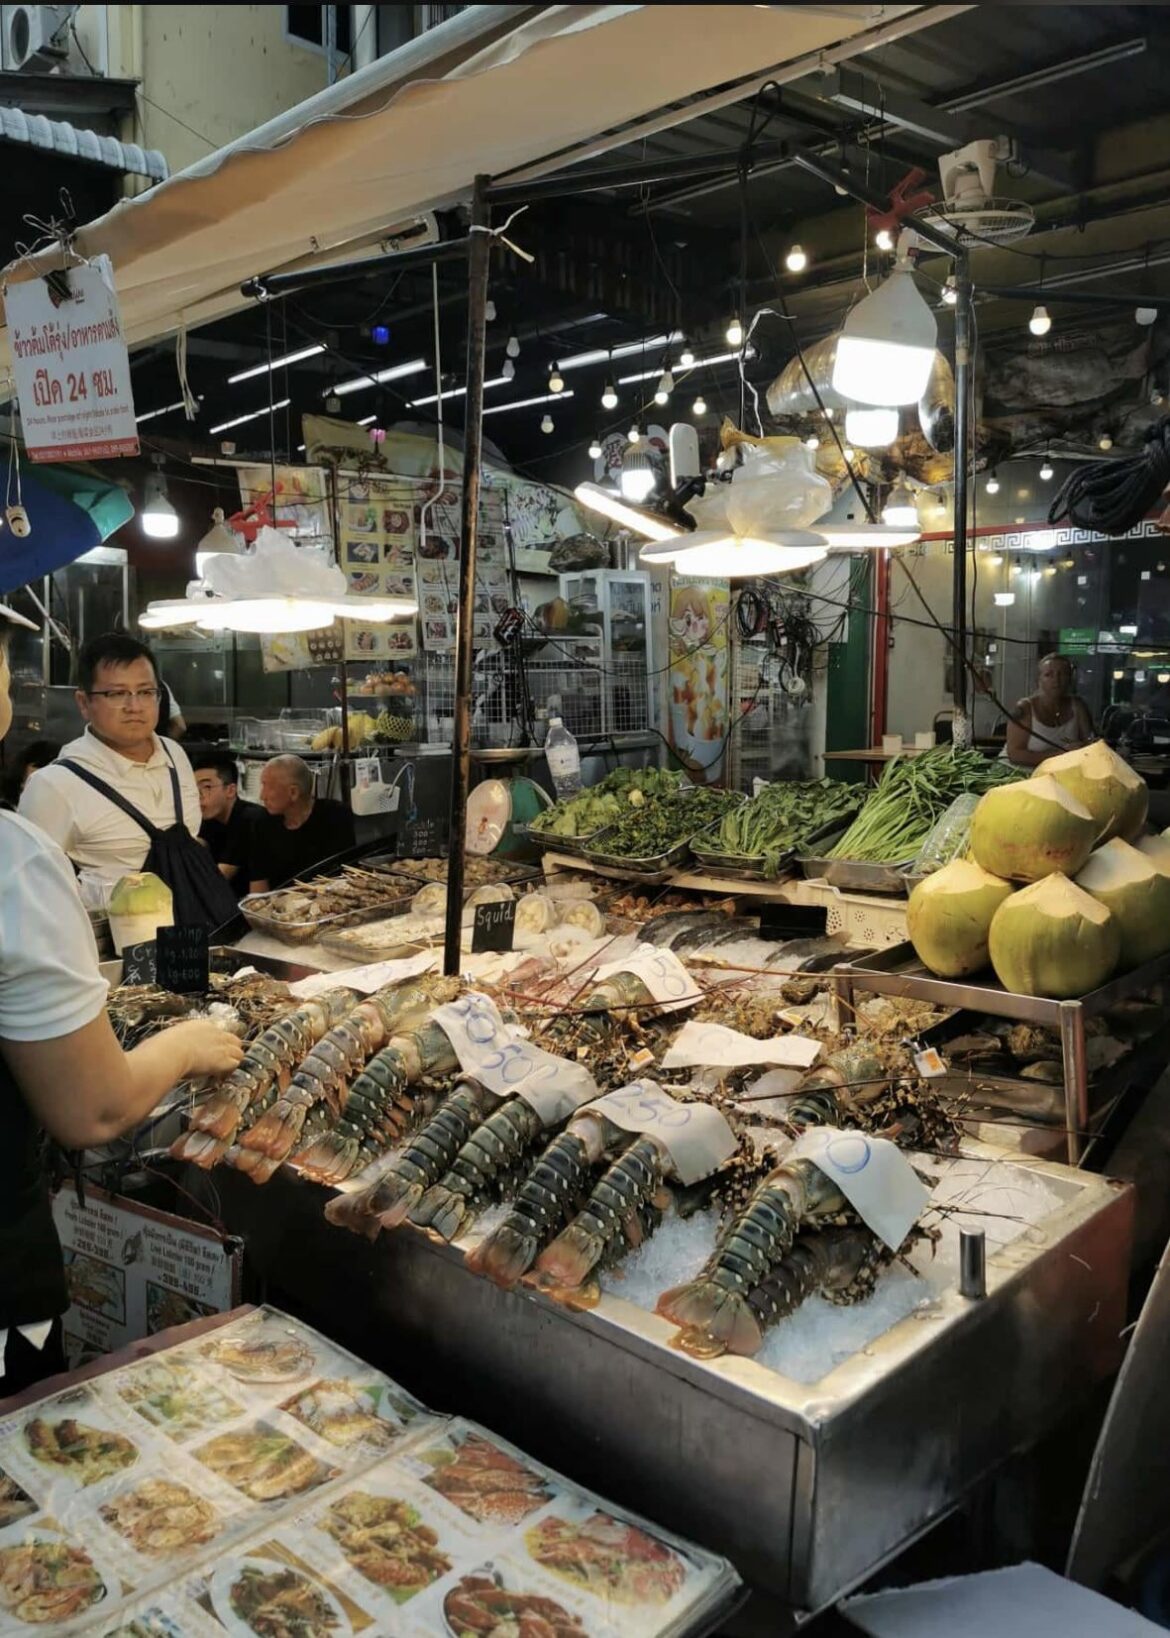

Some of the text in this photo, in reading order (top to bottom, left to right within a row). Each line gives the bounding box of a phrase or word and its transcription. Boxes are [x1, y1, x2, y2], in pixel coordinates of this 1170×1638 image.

[33, 368, 118, 406] เปิด 24 ชม.
[476, 903, 513, 931] Squid
